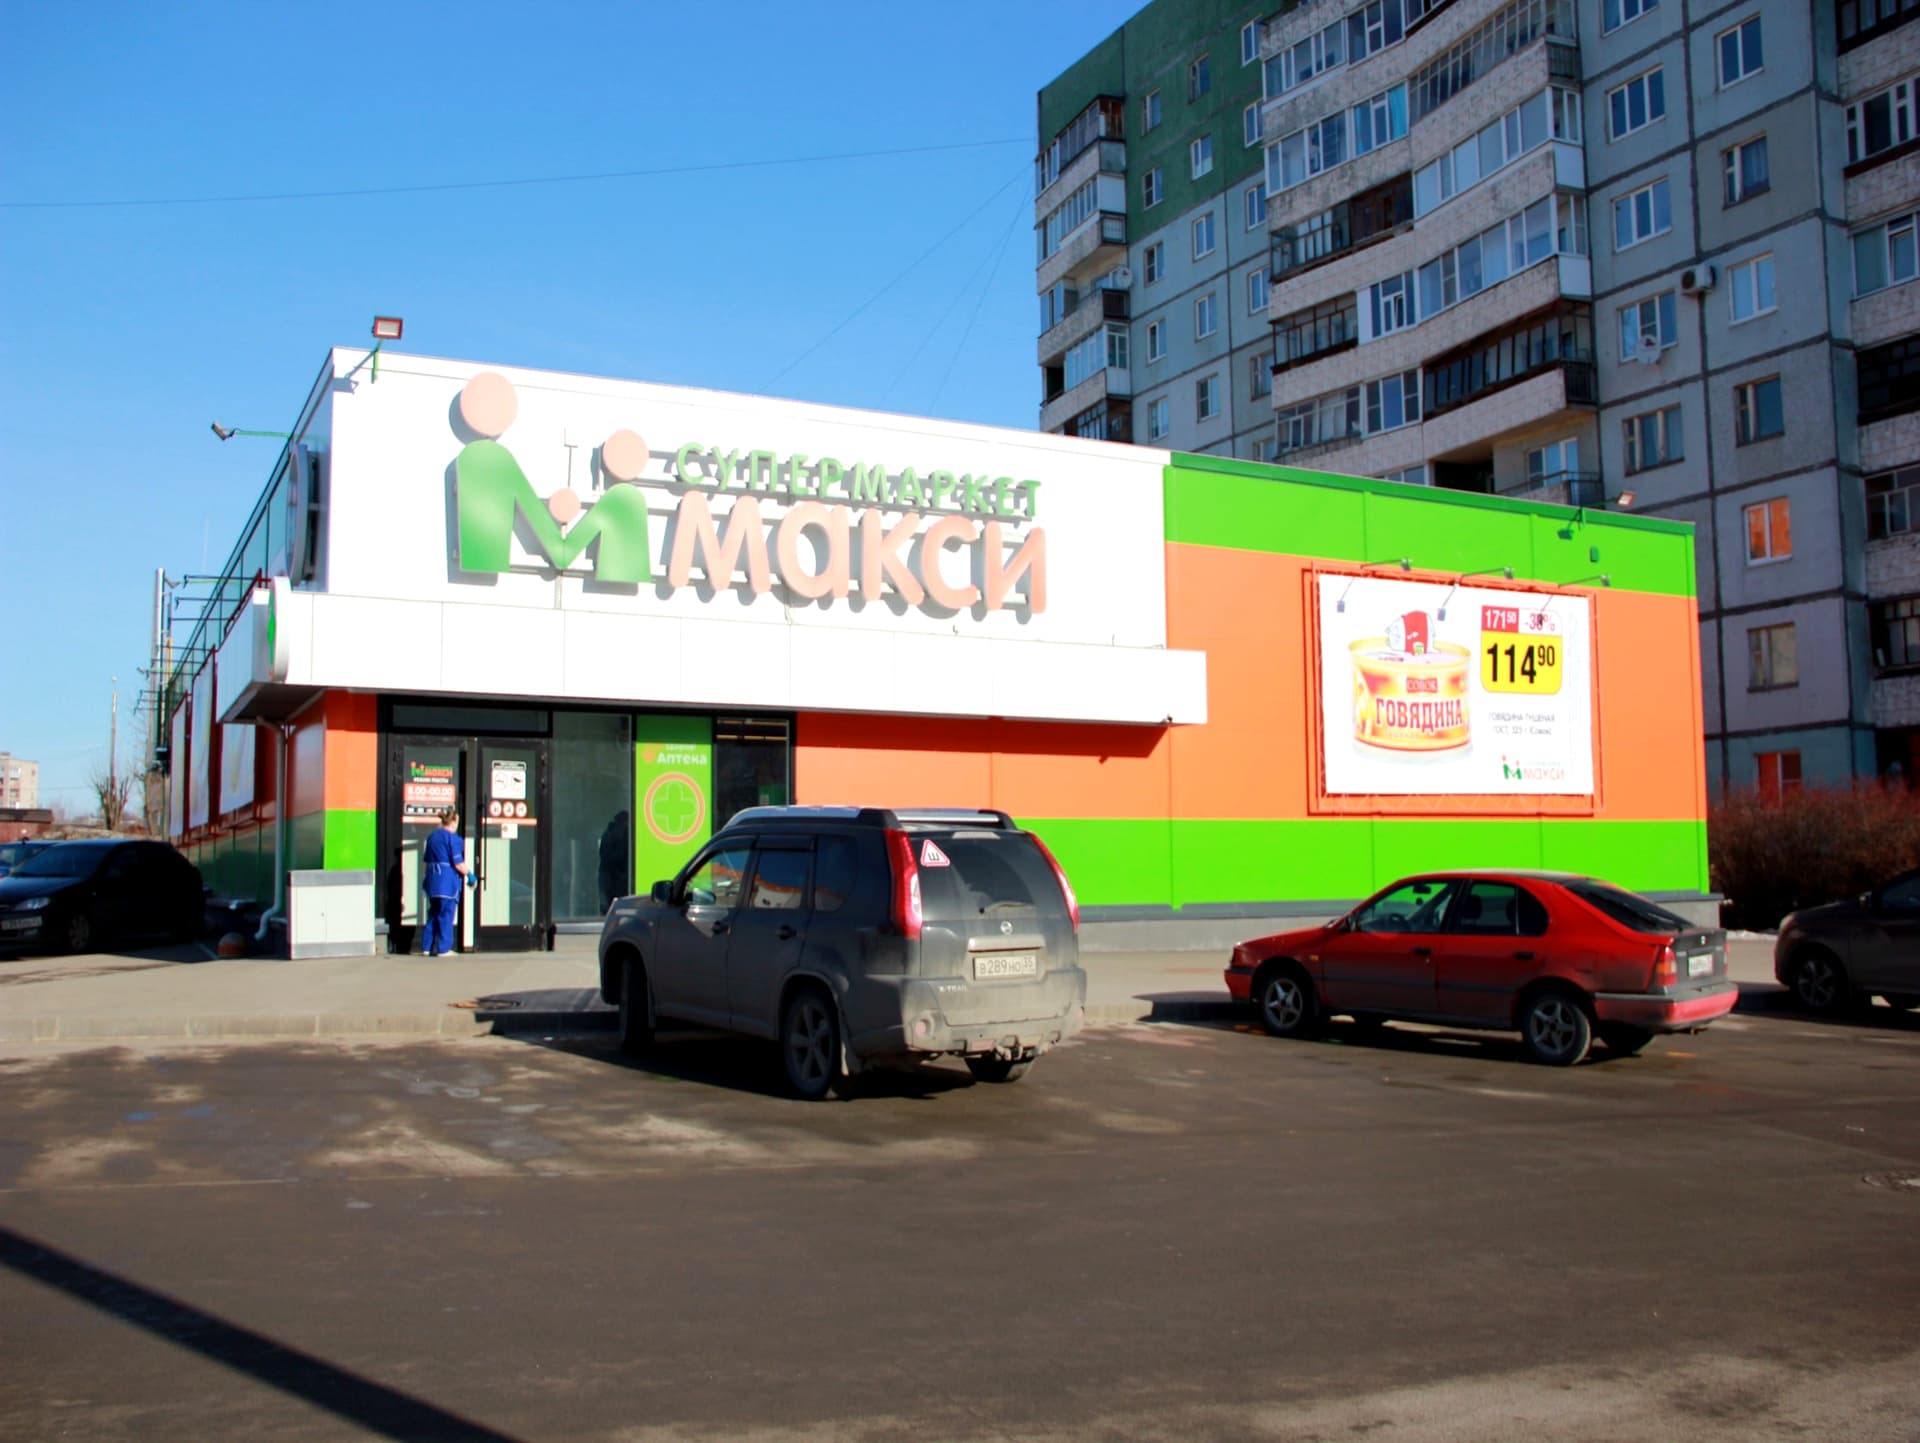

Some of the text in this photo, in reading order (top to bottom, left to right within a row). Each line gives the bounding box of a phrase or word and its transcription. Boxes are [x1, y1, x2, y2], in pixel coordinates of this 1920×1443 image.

[675, 442, 1042, 518] СУПЕРМАРКЕТ
[1375, 698, 1463, 733] ГОВЯДИНА
[657, 752, 708, 765] Аптека
